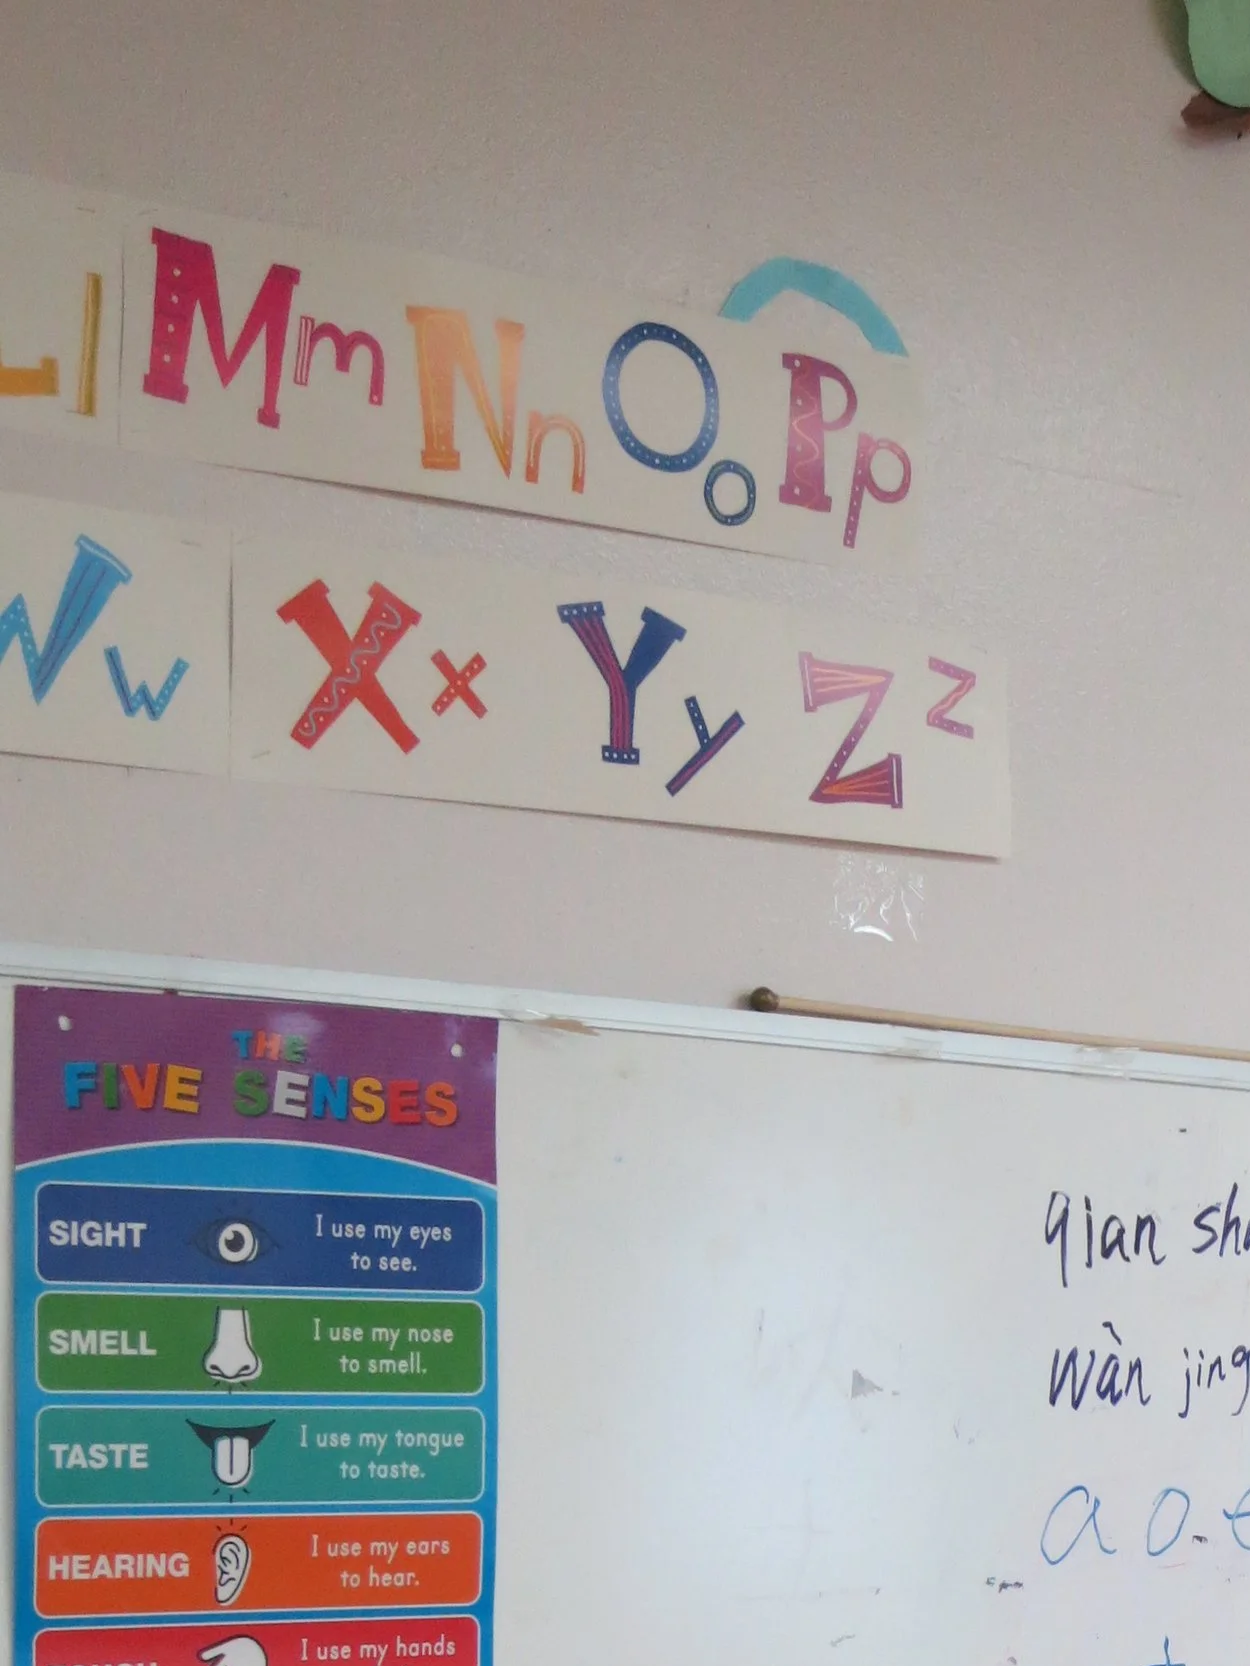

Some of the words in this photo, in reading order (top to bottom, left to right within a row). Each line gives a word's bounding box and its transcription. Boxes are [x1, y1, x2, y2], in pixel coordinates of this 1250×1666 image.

[232, 1029, 308, 1062] THE
[63, 1061, 202, 1114] FIVE
[232, 1070, 459, 1128] SENSES
[48, 1219, 147, 1249] SIGHT
[316, 1214, 323, 1238] I
[332, 1223, 365, 1239] use
[374, 1224, 402, 1245] my
[409, 1224, 453, 1244] eyes
[350, 1251, 371, 1271] to
[378, 1255, 418, 1273] see.
[48, 1329, 157, 1356] SMELL
[313, 1318, 321, 1341] I
[328, 1325, 363, 1341] use
[371, 1326, 400, 1349] my
[407, 1326, 454, 1344] nose
[339, 1354, 360, 1374] to
[367, 1355, 428, 1375] smell.
[300, 1424, 308, 1448] I
[316, 1431, 351, 1447] use
[359, 1431, 388, 1451] my
[396, 1424, 465, 1453] tongue
[49, 1443, 149, 1469] TASTE
[339, 1461, 361, 1479] to
[368, 1461, 426, 1480] taste.
[1040, 1485, 1117, 1566] a
[1146, 1487, 1190, 1557] o
[311, 1535, 319, 1558] I
[327, 1540, 361, 1557] use
[369, 1541, 399, 1563] my
[406, 1539, 450, 1556] ears
[48, 1552, 190, 1579] HEARING
[340, 1568, 361, 1588] to
[368, 1567, 420, 1588] hear.
[300, 1639, 309, 1662] I
[316, 1644, 351, 1660] use
[359, 1644, 389, 1666] my
[395, 1635, 456, 1657] hands
